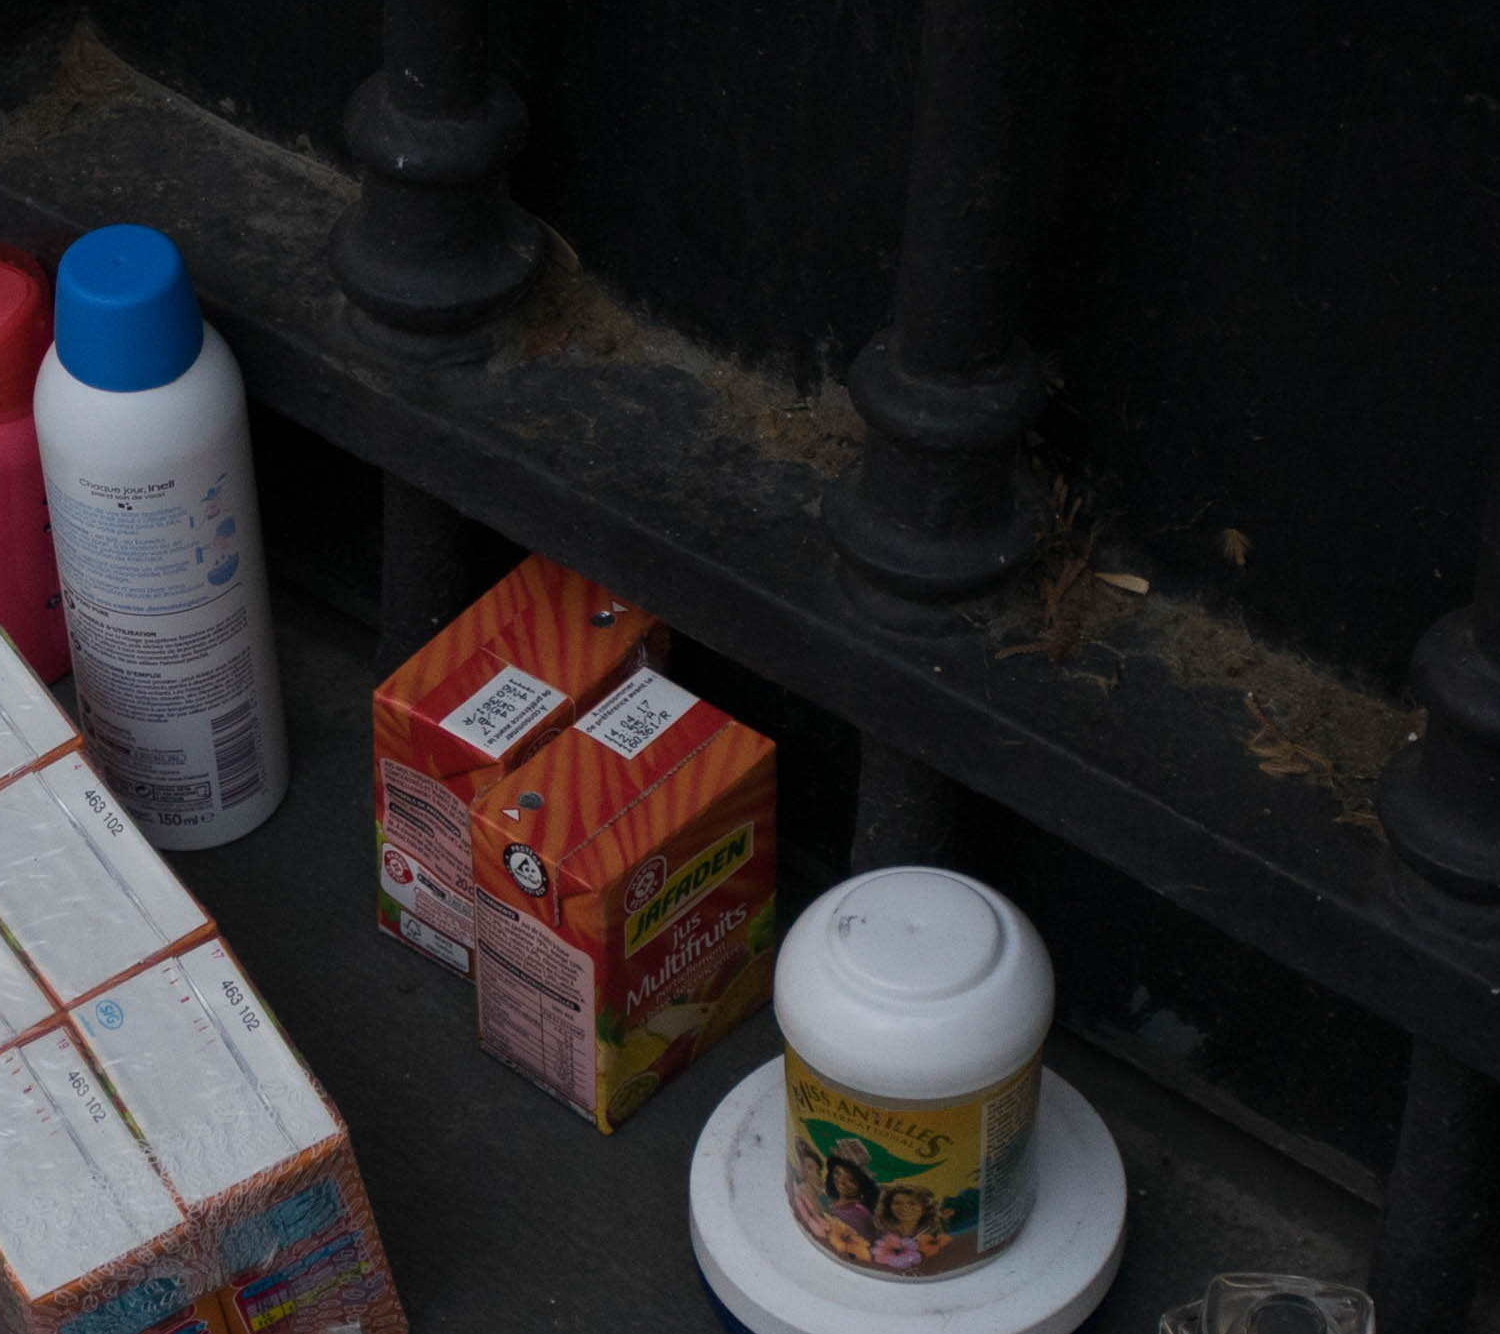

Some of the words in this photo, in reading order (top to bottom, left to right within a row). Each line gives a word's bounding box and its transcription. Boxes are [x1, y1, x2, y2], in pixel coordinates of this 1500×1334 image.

[85, 789, 106, 813] 463
[101, 812, 125, 837] 102
[158, 813, 183, 827] 150
[184, 813, 199, 827] ml
[673, 912, 701, 950] jus
[626, 902, 747, 1015] Multifruits
[222, 979, 243, 1006] 463
[238, 1006, 261, 1032] 102
[68, 1070, 89, 1096] 463
[85, 1096, 107, 1123] 102
